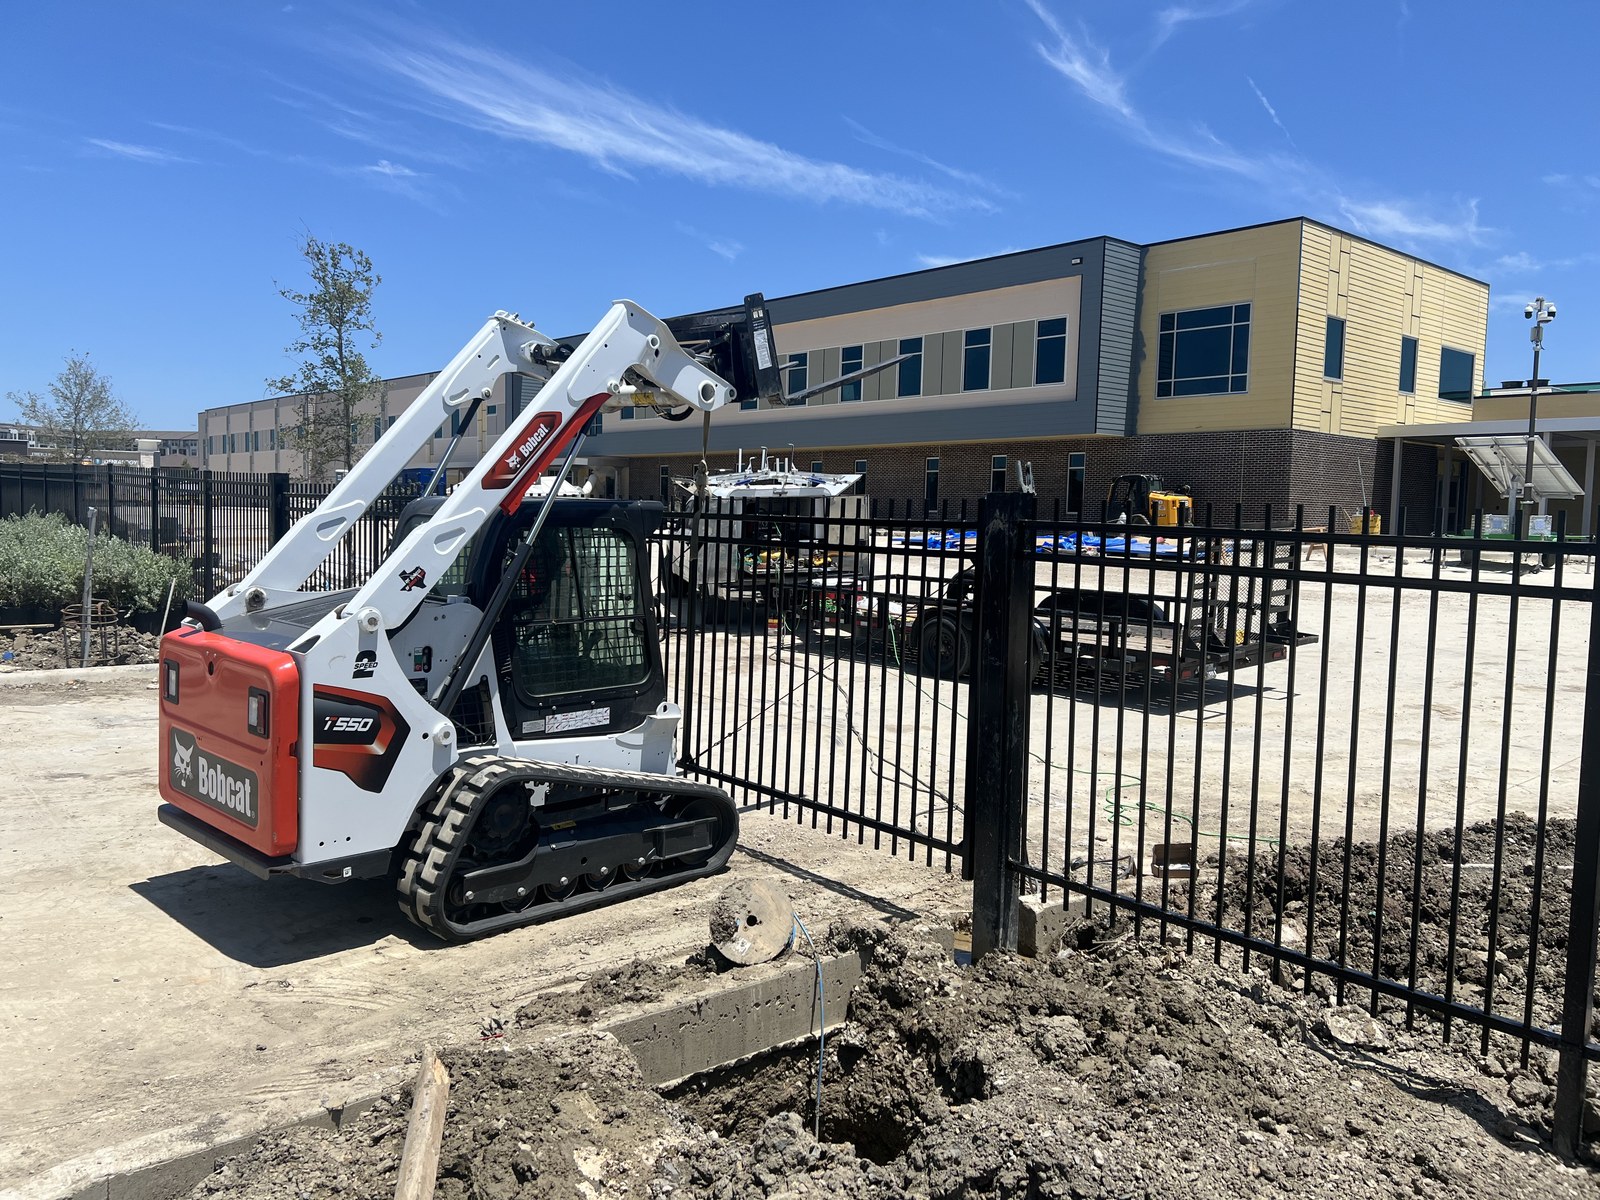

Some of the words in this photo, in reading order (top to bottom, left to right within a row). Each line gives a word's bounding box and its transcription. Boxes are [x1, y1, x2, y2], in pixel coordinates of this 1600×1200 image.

[519, 423, 549, 457] Bobcat
[352, 649, 377, 679] 2
[354, 662, 378, 670] SPEED
[323, 716, 374, 732] T550
[198, 756, 251, 817] Bobcat
